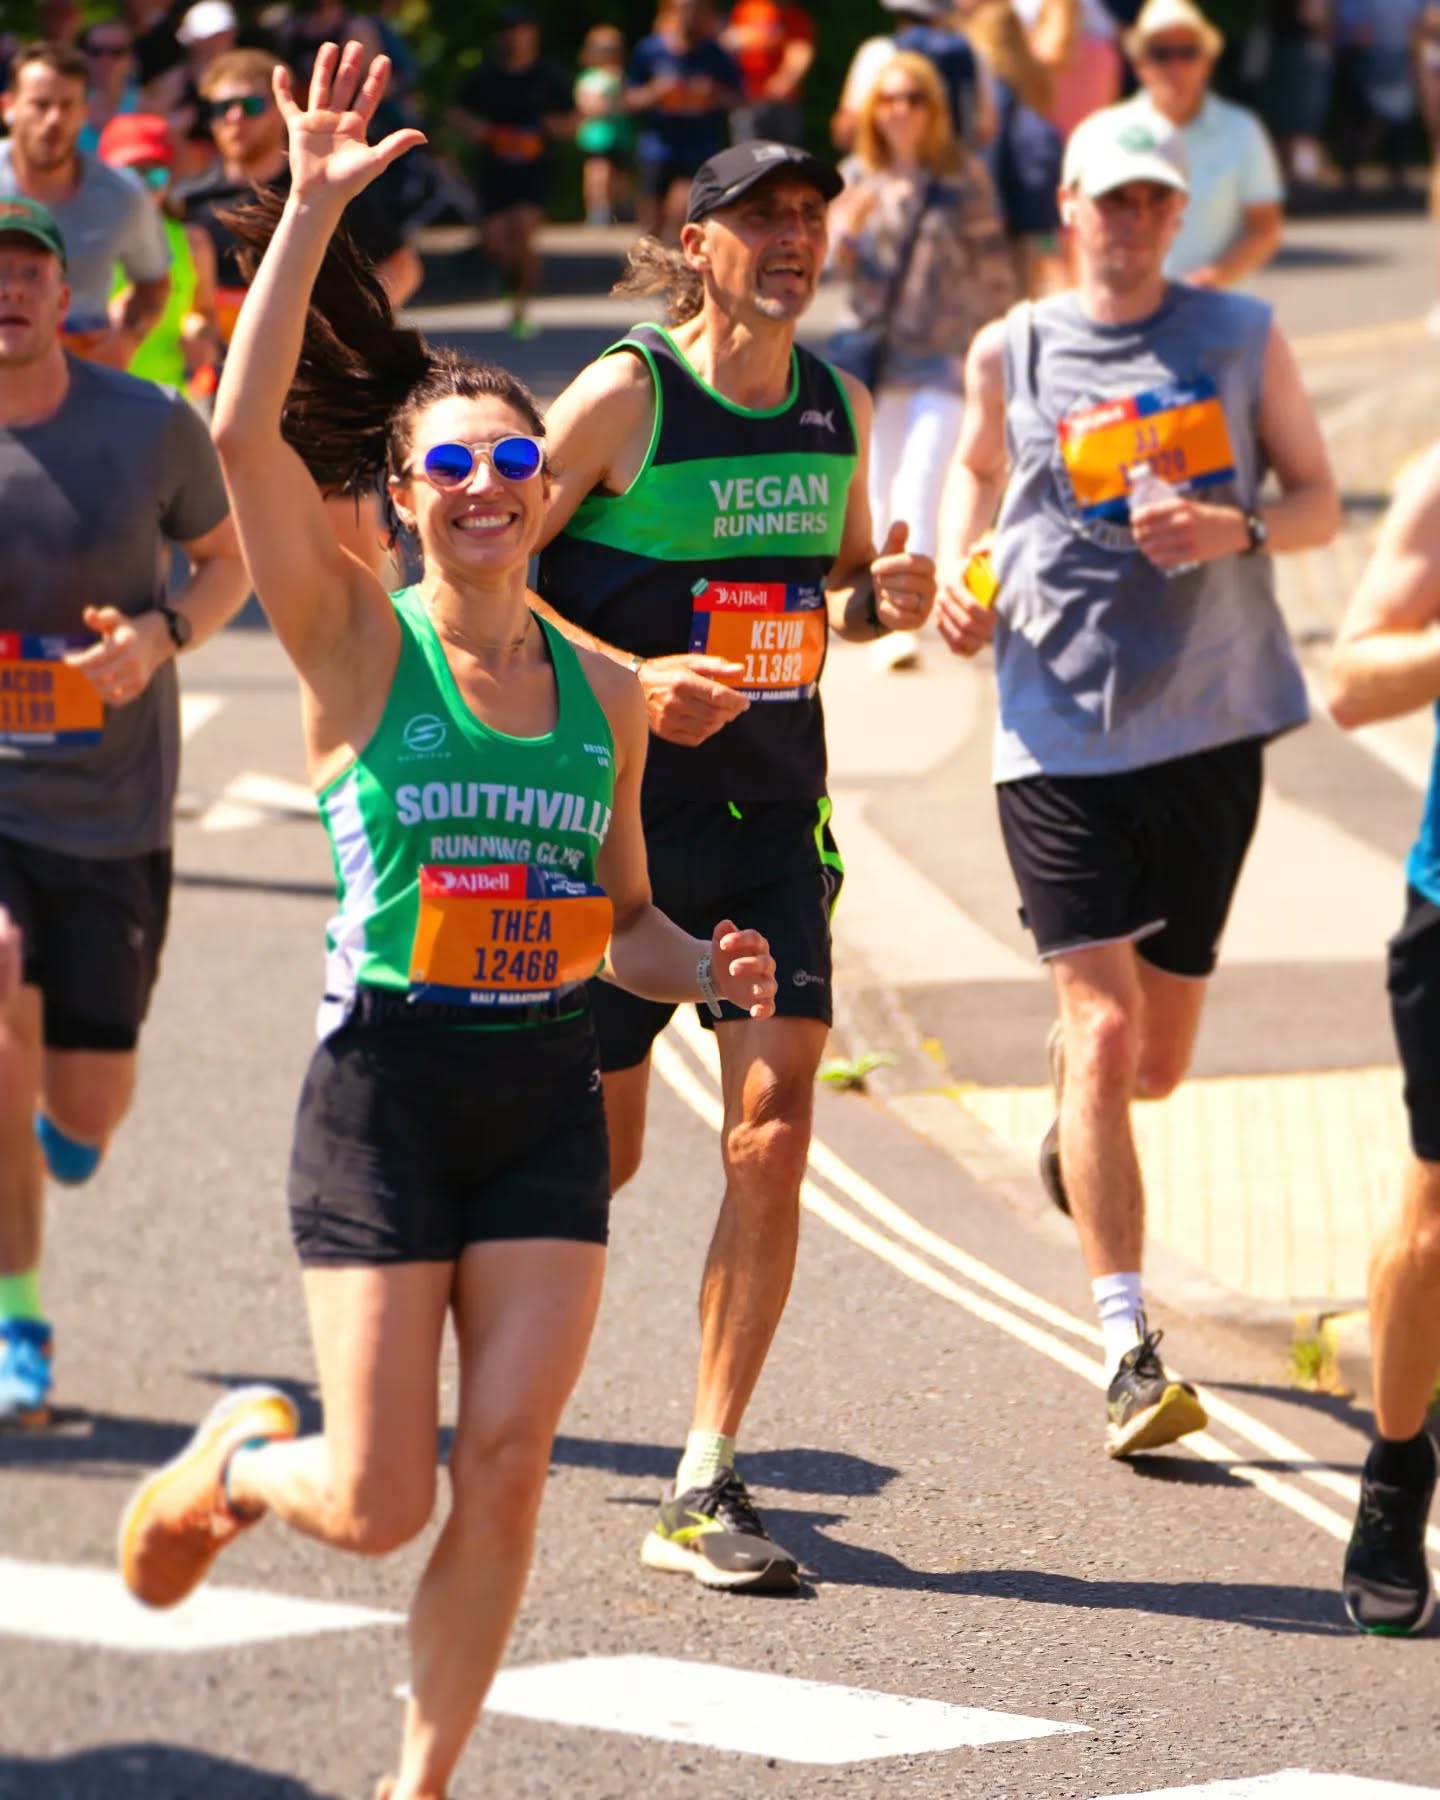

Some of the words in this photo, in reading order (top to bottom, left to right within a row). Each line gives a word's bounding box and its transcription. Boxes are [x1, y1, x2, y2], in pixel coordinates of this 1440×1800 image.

[709, 473, 829, 511] VEGAN
[713, 511, 827, 538] RUNNERS
[751, 620, 804, 651] KEVIN
[742, 653, 803, 683] 11392
[430, 834, 532, 862] RUNNING
[491, 908, 552, 943] THEA
[473, 946, 559, 982] 12468
[469, 991, 495, 1004] HALF
